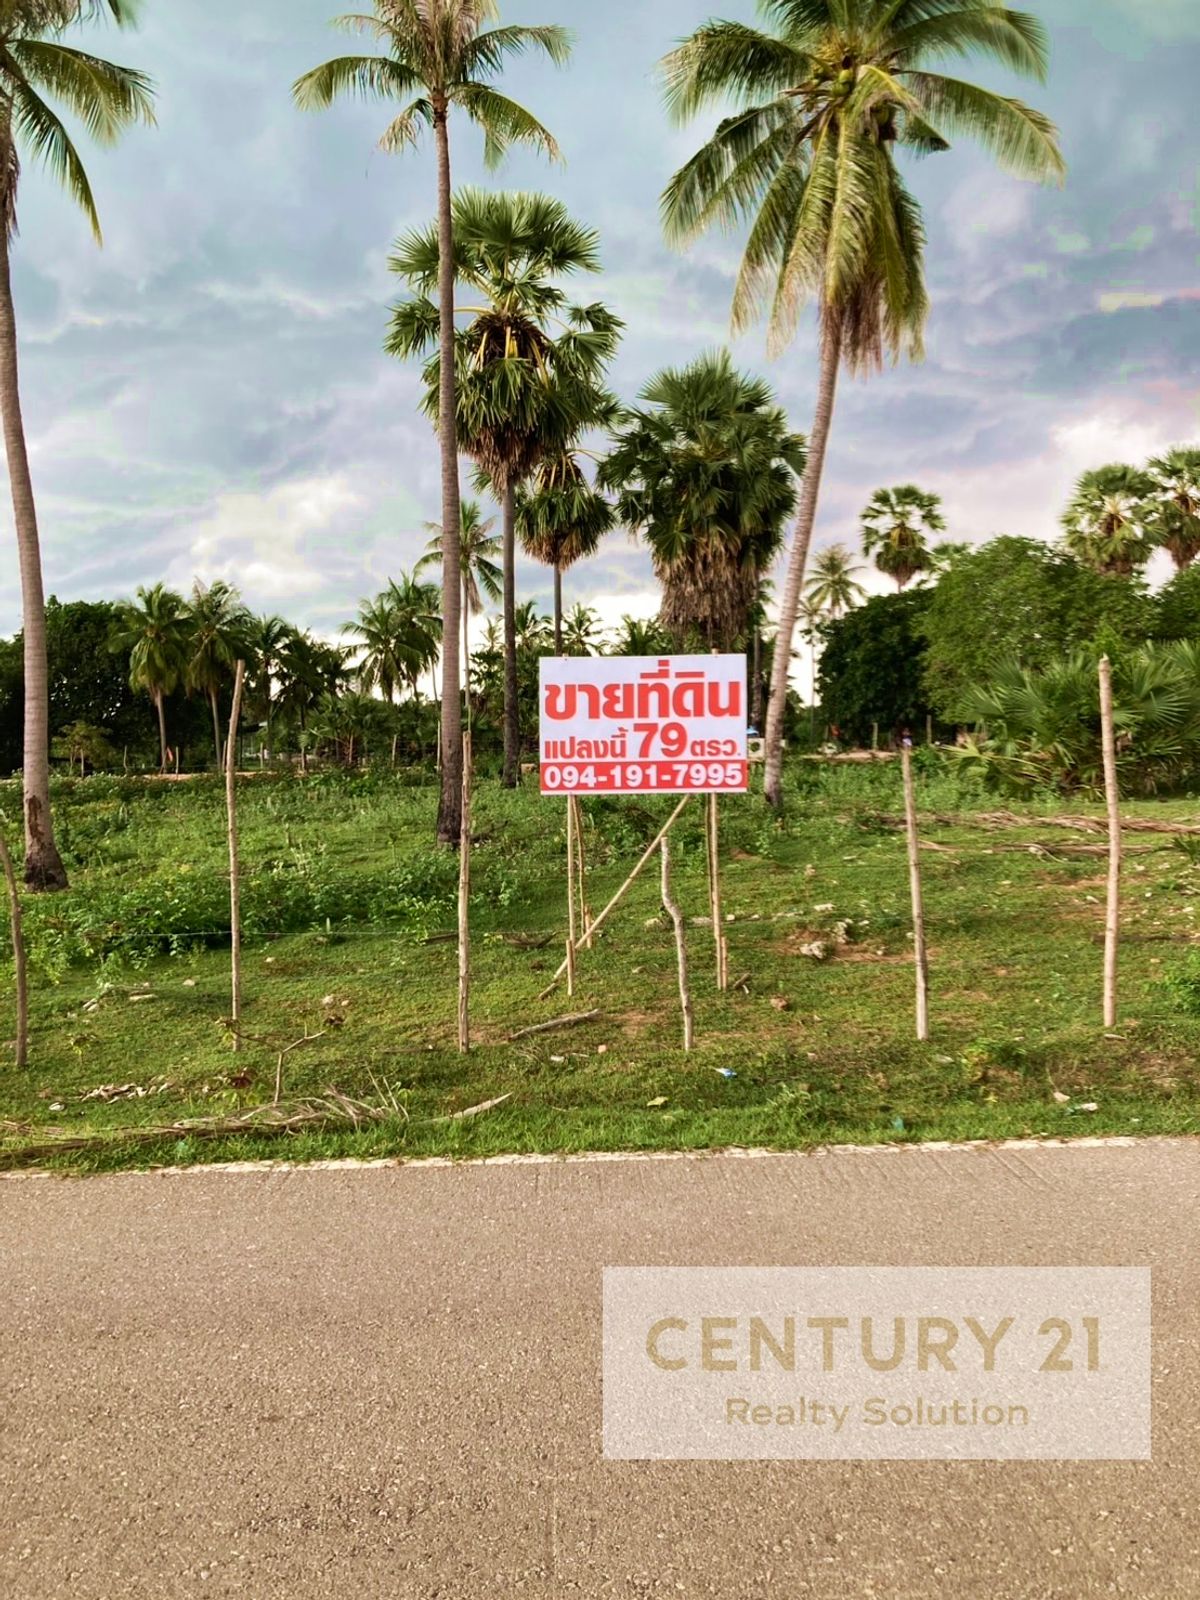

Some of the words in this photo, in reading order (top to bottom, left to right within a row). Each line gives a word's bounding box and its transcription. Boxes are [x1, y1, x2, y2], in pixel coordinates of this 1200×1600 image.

[544, 659, 741, 720] ขายที่ดิน
[544, 727, 629, 759] แปลงนี้
[633, 721, 688, 758] 79
[544, 763, 743, 788] 094-191-7995
